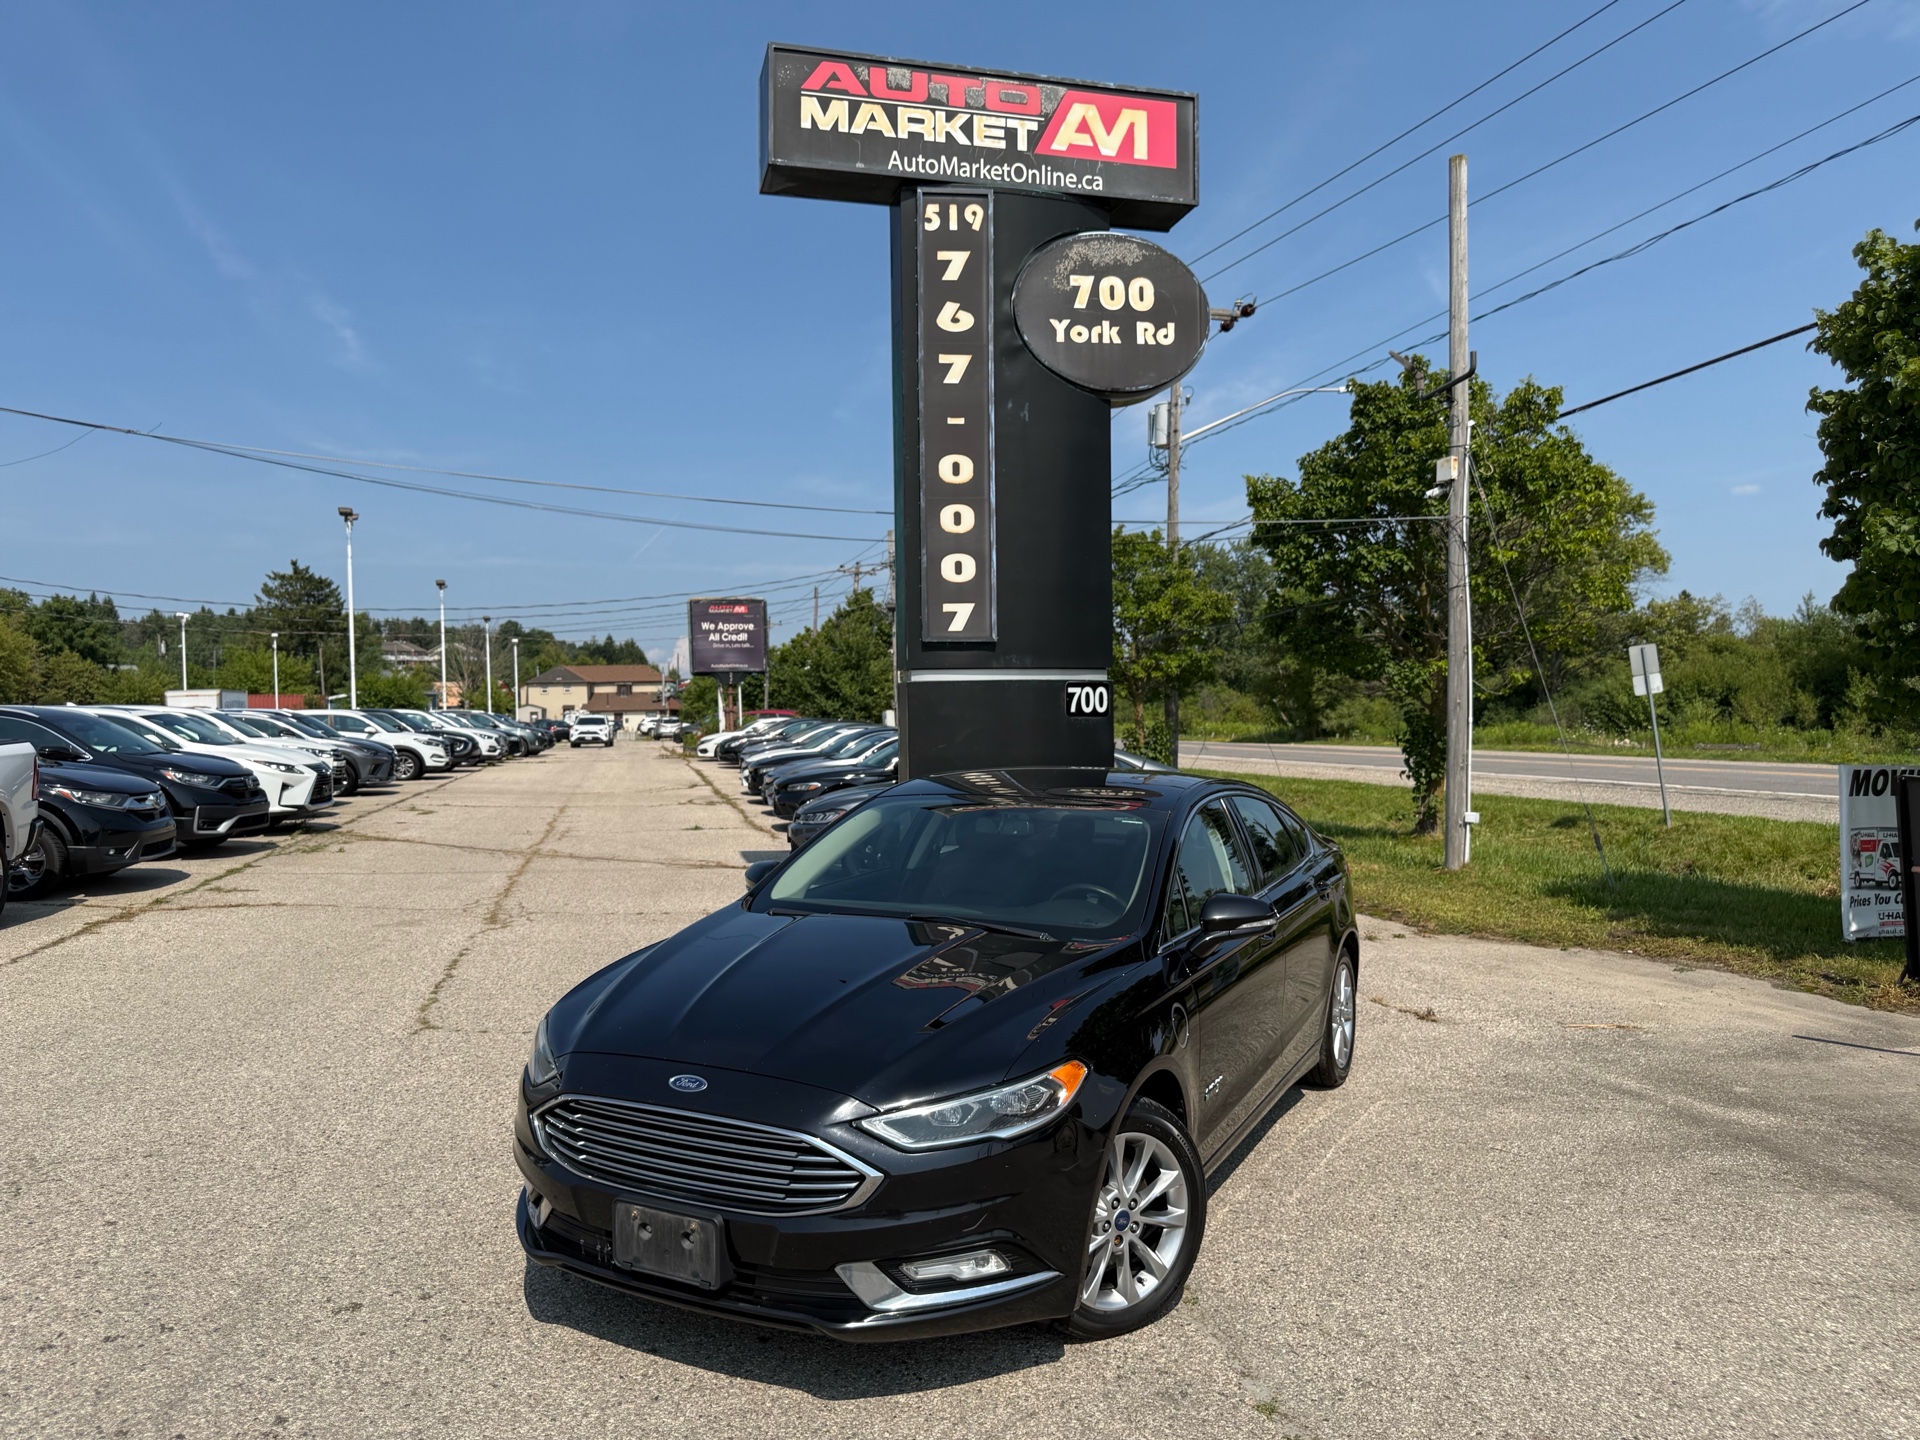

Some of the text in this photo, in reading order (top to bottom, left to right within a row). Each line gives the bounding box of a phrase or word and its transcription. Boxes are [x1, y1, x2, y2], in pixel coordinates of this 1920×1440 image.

[801, 61, 1041, 116] AUTO
[801, 96, 1039, 152] MARKET
[888, 150, 1104, 191] AutoMarketOnline.ca
[924, 203, 985, 232] 519
[1069, 274, 1155, 312] 700
[1049, 318, 1176, 346] York Rd
[701, 622, 754, 632] We Approve
[708, 632, 748, 641] All Credit
[1067, 686, 1109, 714] 700
[1849, 893, 1872, 909] Prices
[1874, 892, 1891, 906] You
[676, 1077, 700, 1089] Ford
